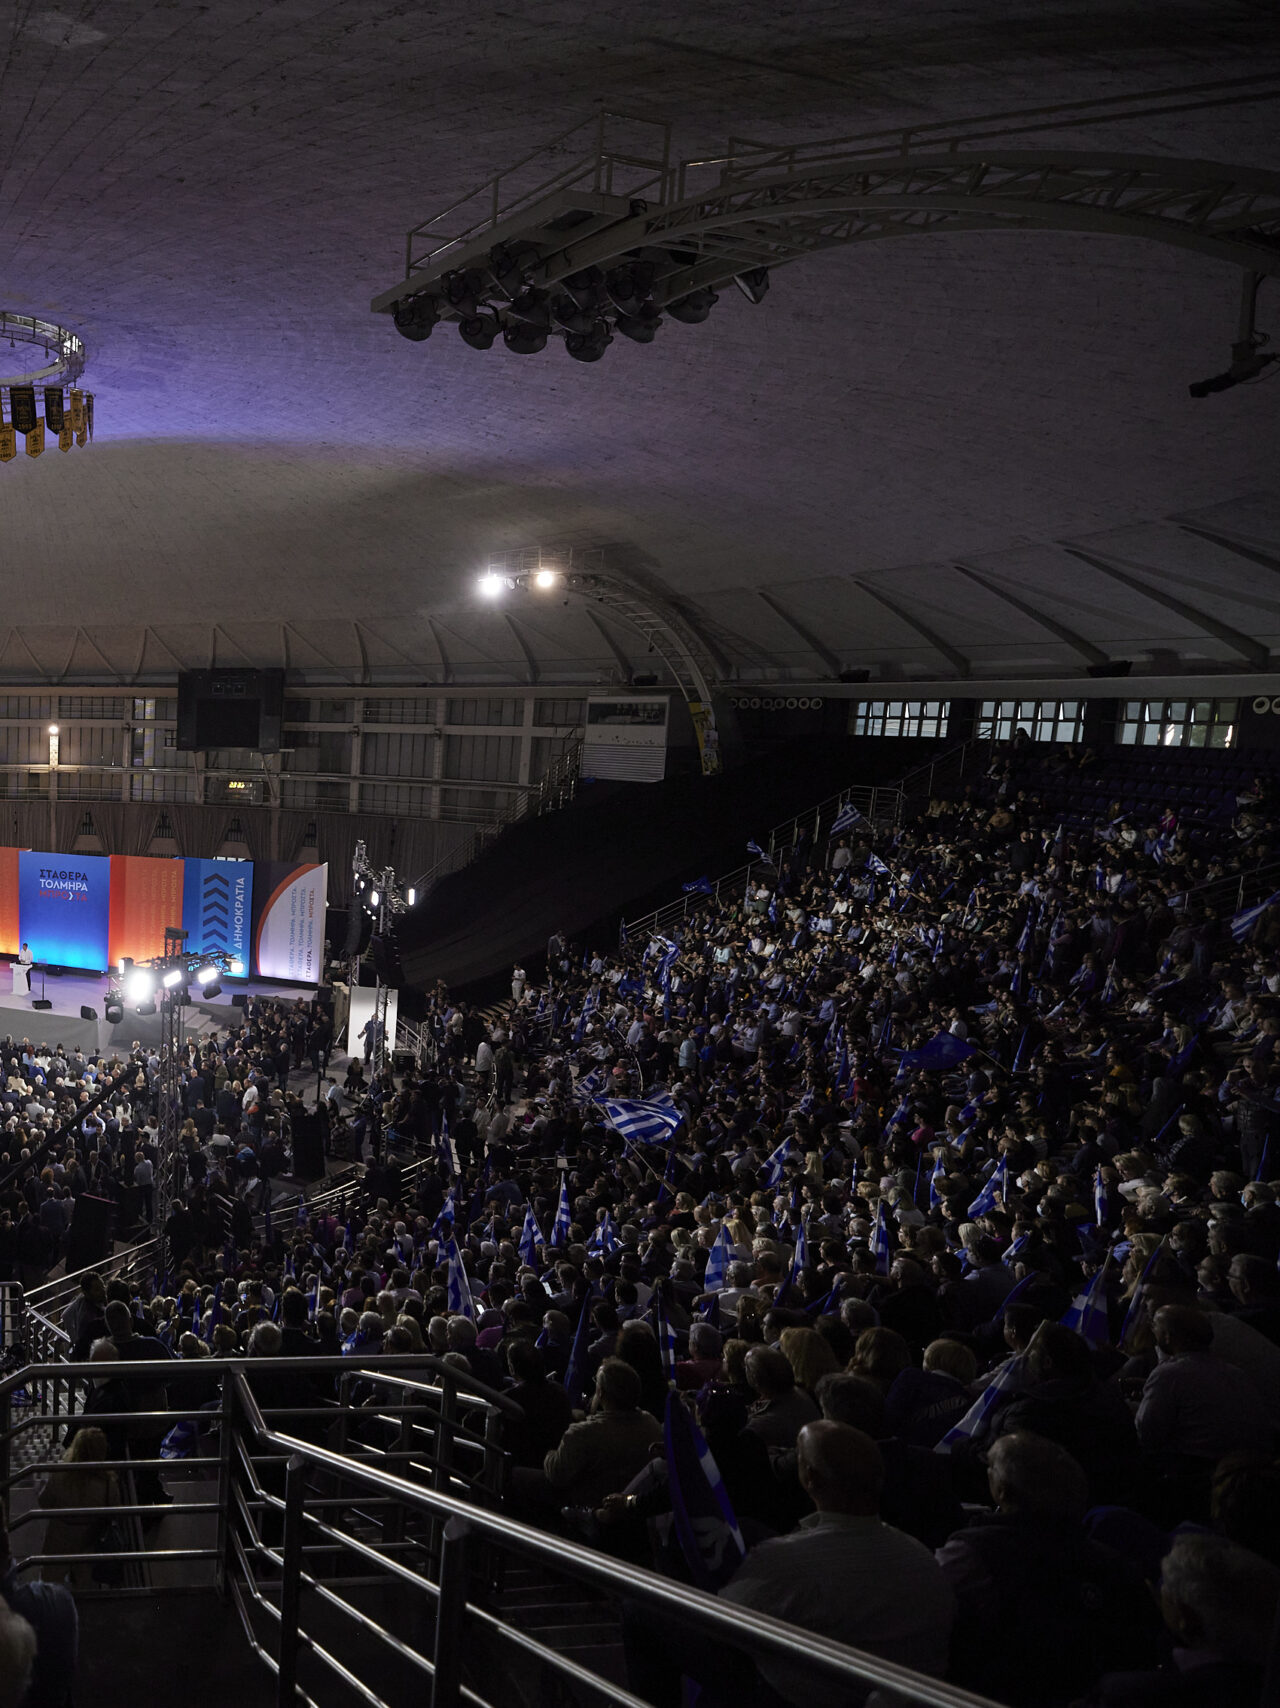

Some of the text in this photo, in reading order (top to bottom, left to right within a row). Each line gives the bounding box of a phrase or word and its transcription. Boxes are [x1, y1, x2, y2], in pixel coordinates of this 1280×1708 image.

[39, 869, 88, 881] ΣΤΑΘΕΡΑ
[39, 879, 88, 892] ΤΟΛΜΗΡΑ
[233, 877, 245, 950] ΔΗΜΟΚΡΑΤΙΑ
